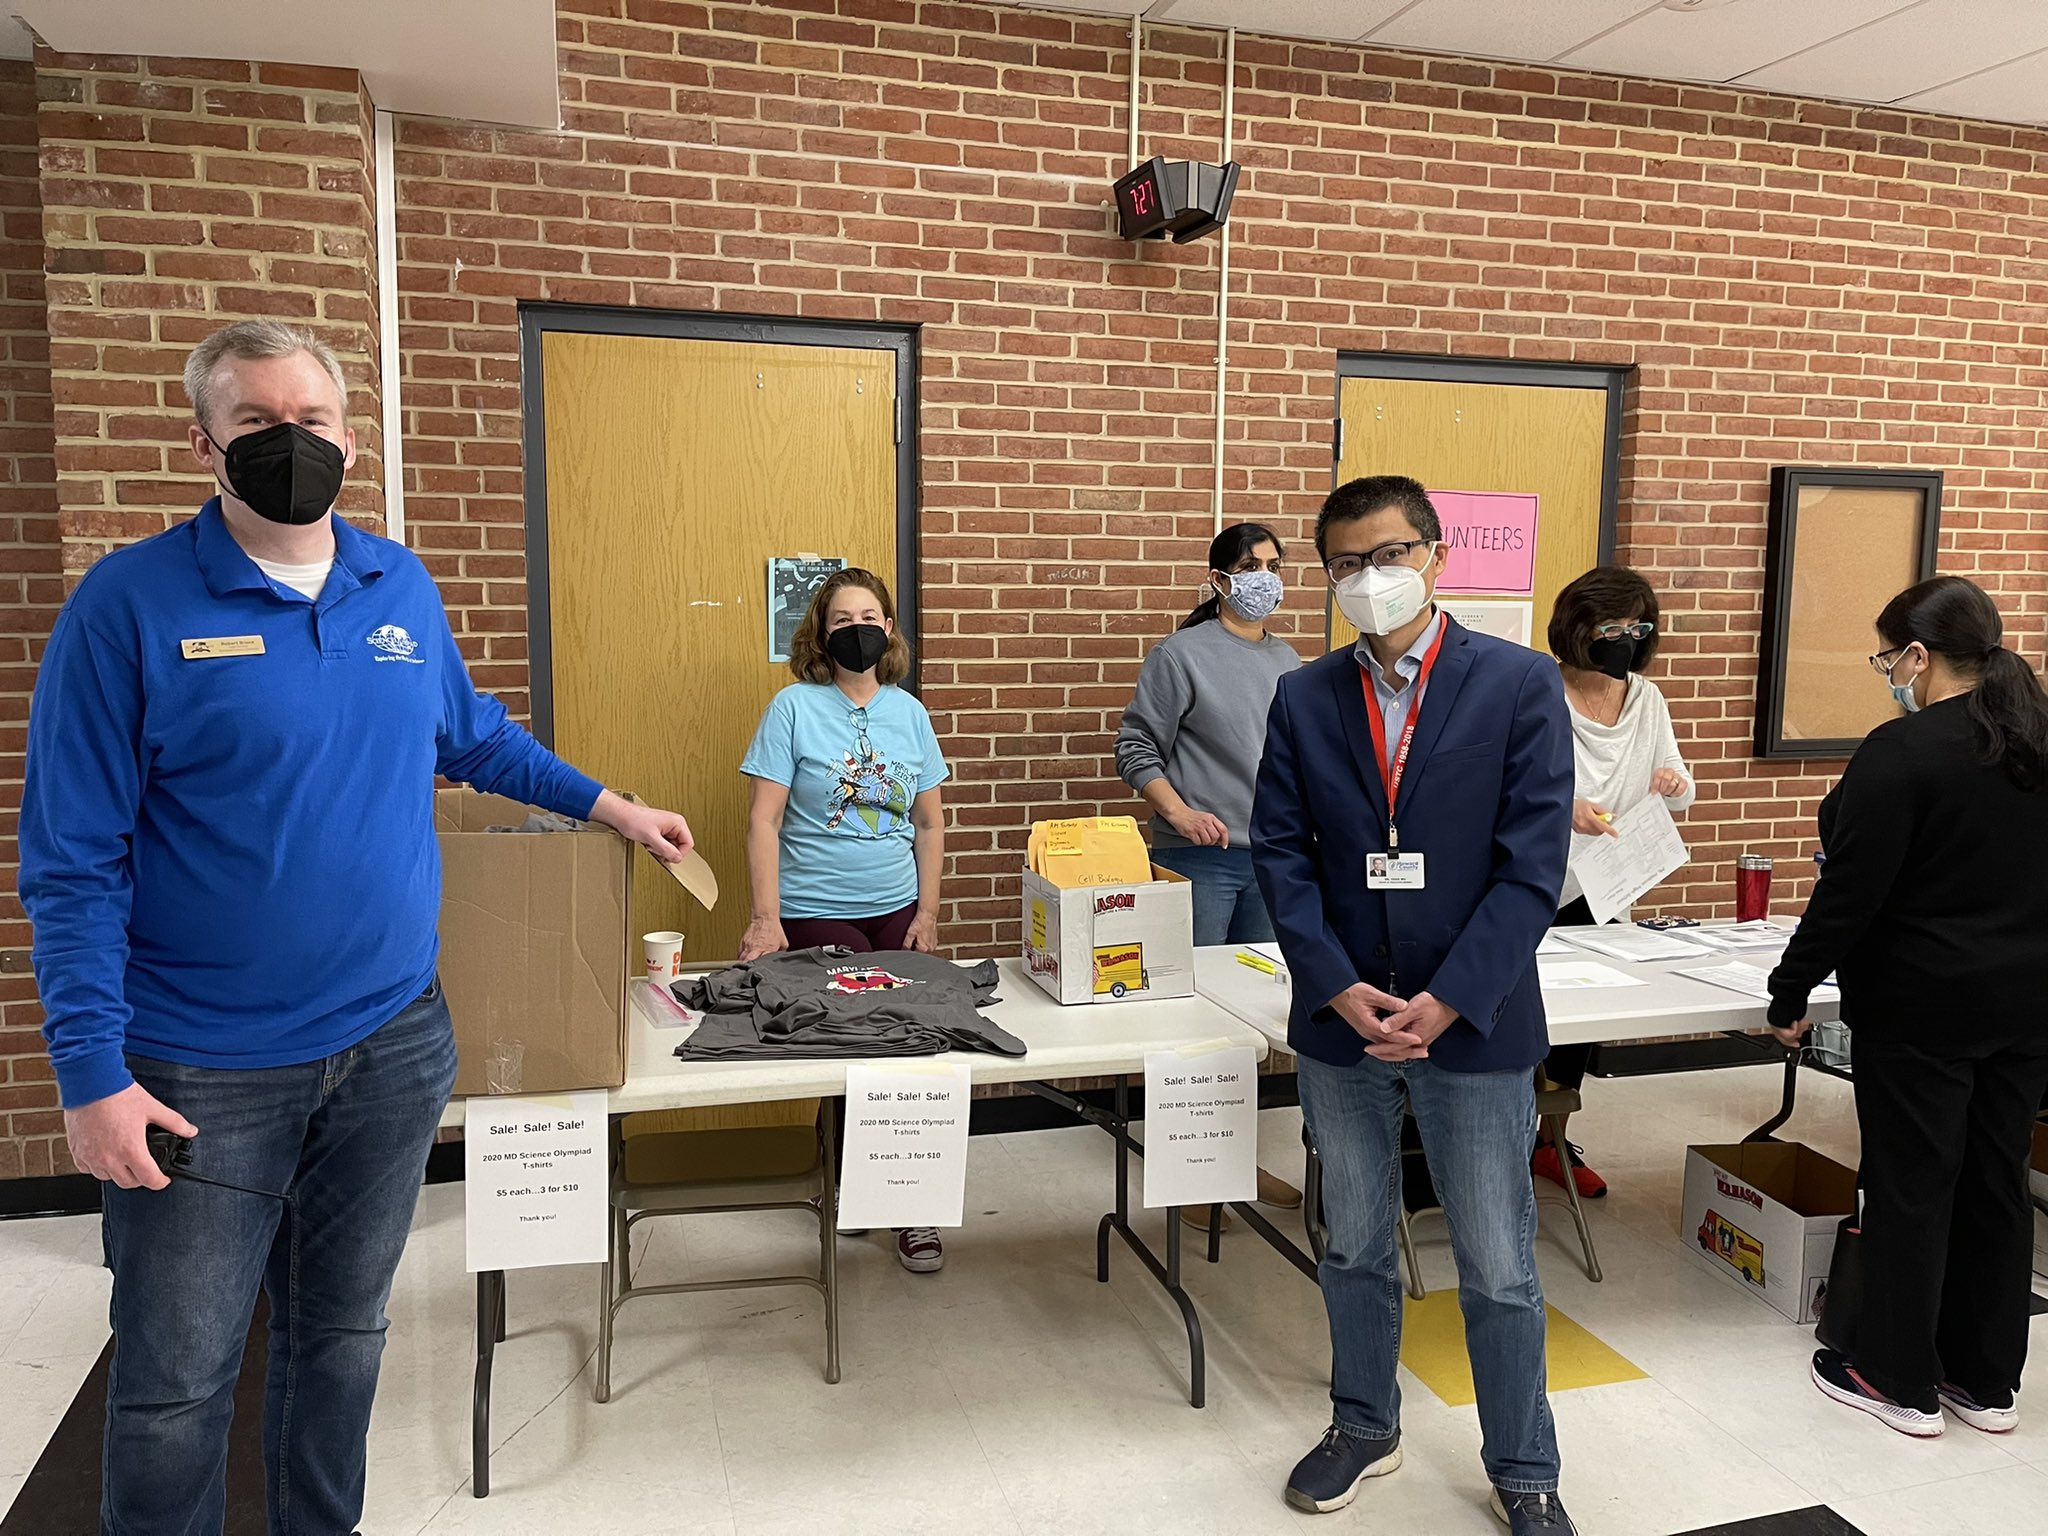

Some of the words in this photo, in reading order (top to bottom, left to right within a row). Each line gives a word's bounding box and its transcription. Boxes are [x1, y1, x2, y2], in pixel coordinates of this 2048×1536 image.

[1445, 526, 1524, 551] UNTEERS
[1078, 874, 1094, 884] Cell
[1164, 1077, 1186, 1086] Sale!
[1191, 1076, 1212, 1084] Sale!
[1217, 1074, 1239, 1083] Sale!
[867, 1092, 892, 1101] Sale!
[896, 1092, 921, 1101] Sale!
[926, 1092, 950, 1101] Sale!
[1188, 1100, 1213, 1108] Science
[922, 1118, 955, 1126] Olympiad
[490, 1124, 518, 1135] Sale!
[524, 1122, 551, 1133] Sale!
[557, 1120, 584, 1131] Sale!
[482, 1154, 502, 1162] 2020
[520, 1150, 552, 1160] Science
[554, 1148, 592, 1158] Olympiad
[927, 1152, 941, 1160] $10
[522, 1161, 553, 1170] T-shirts
[496, 1189, 507, 1197] $5
[548, 1185, 560, 1194] for
[563, 1184, 579, 1192] $10
